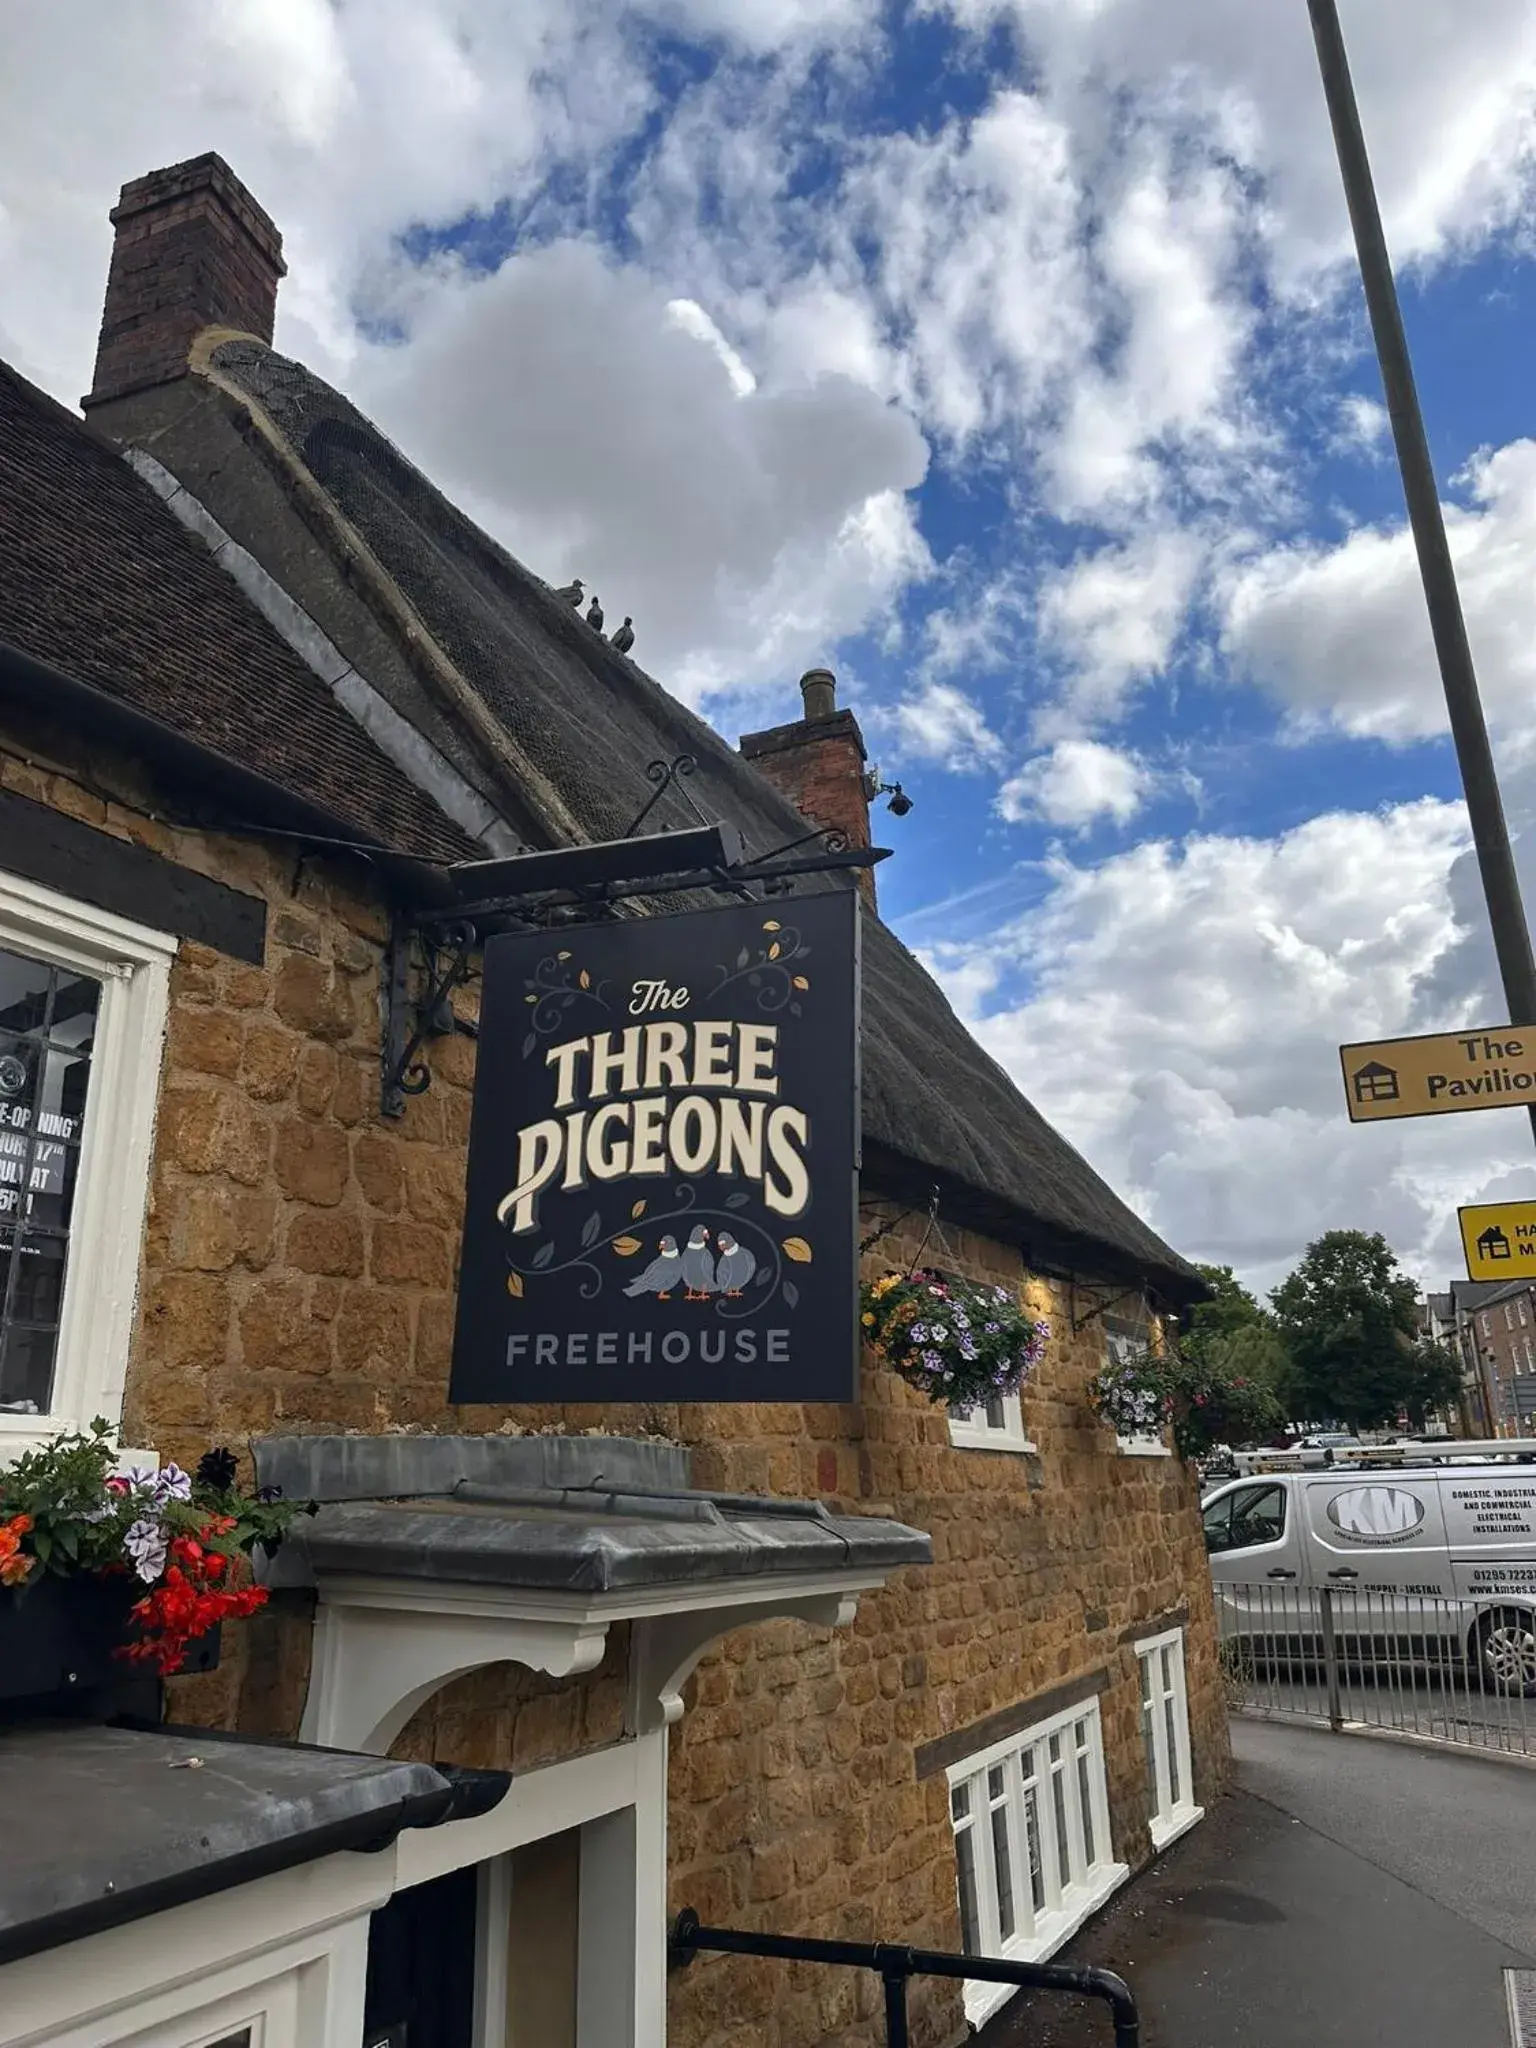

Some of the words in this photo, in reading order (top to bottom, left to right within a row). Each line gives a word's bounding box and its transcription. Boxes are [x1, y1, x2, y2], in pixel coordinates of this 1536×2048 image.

[628, 978, 690, 1015] The
[1459, 1037, 1524, 1062] The
[546, 1020, 780, 1108] THREE
[1427, 1068, 1536, 1098] Pavilio
[496, 1095, 809, 1234] PIGEONS
[29, 1167, 50, 1189] AT
[506, 1329, 791, 1366] FREEHOUSE
[1464, 1502, 1479, 1510] AND
[1480, 1500, 1532, 1509] COMMERCIAL
[1473, 1524, 1531, 1533] INSTALLATIONS
[1477, 1513, 1521, 1521] ELECTRICAL
[1474, 1569, 1506, 1581] 01295
[1405, 1584, 1442, 1595] INSTALL
